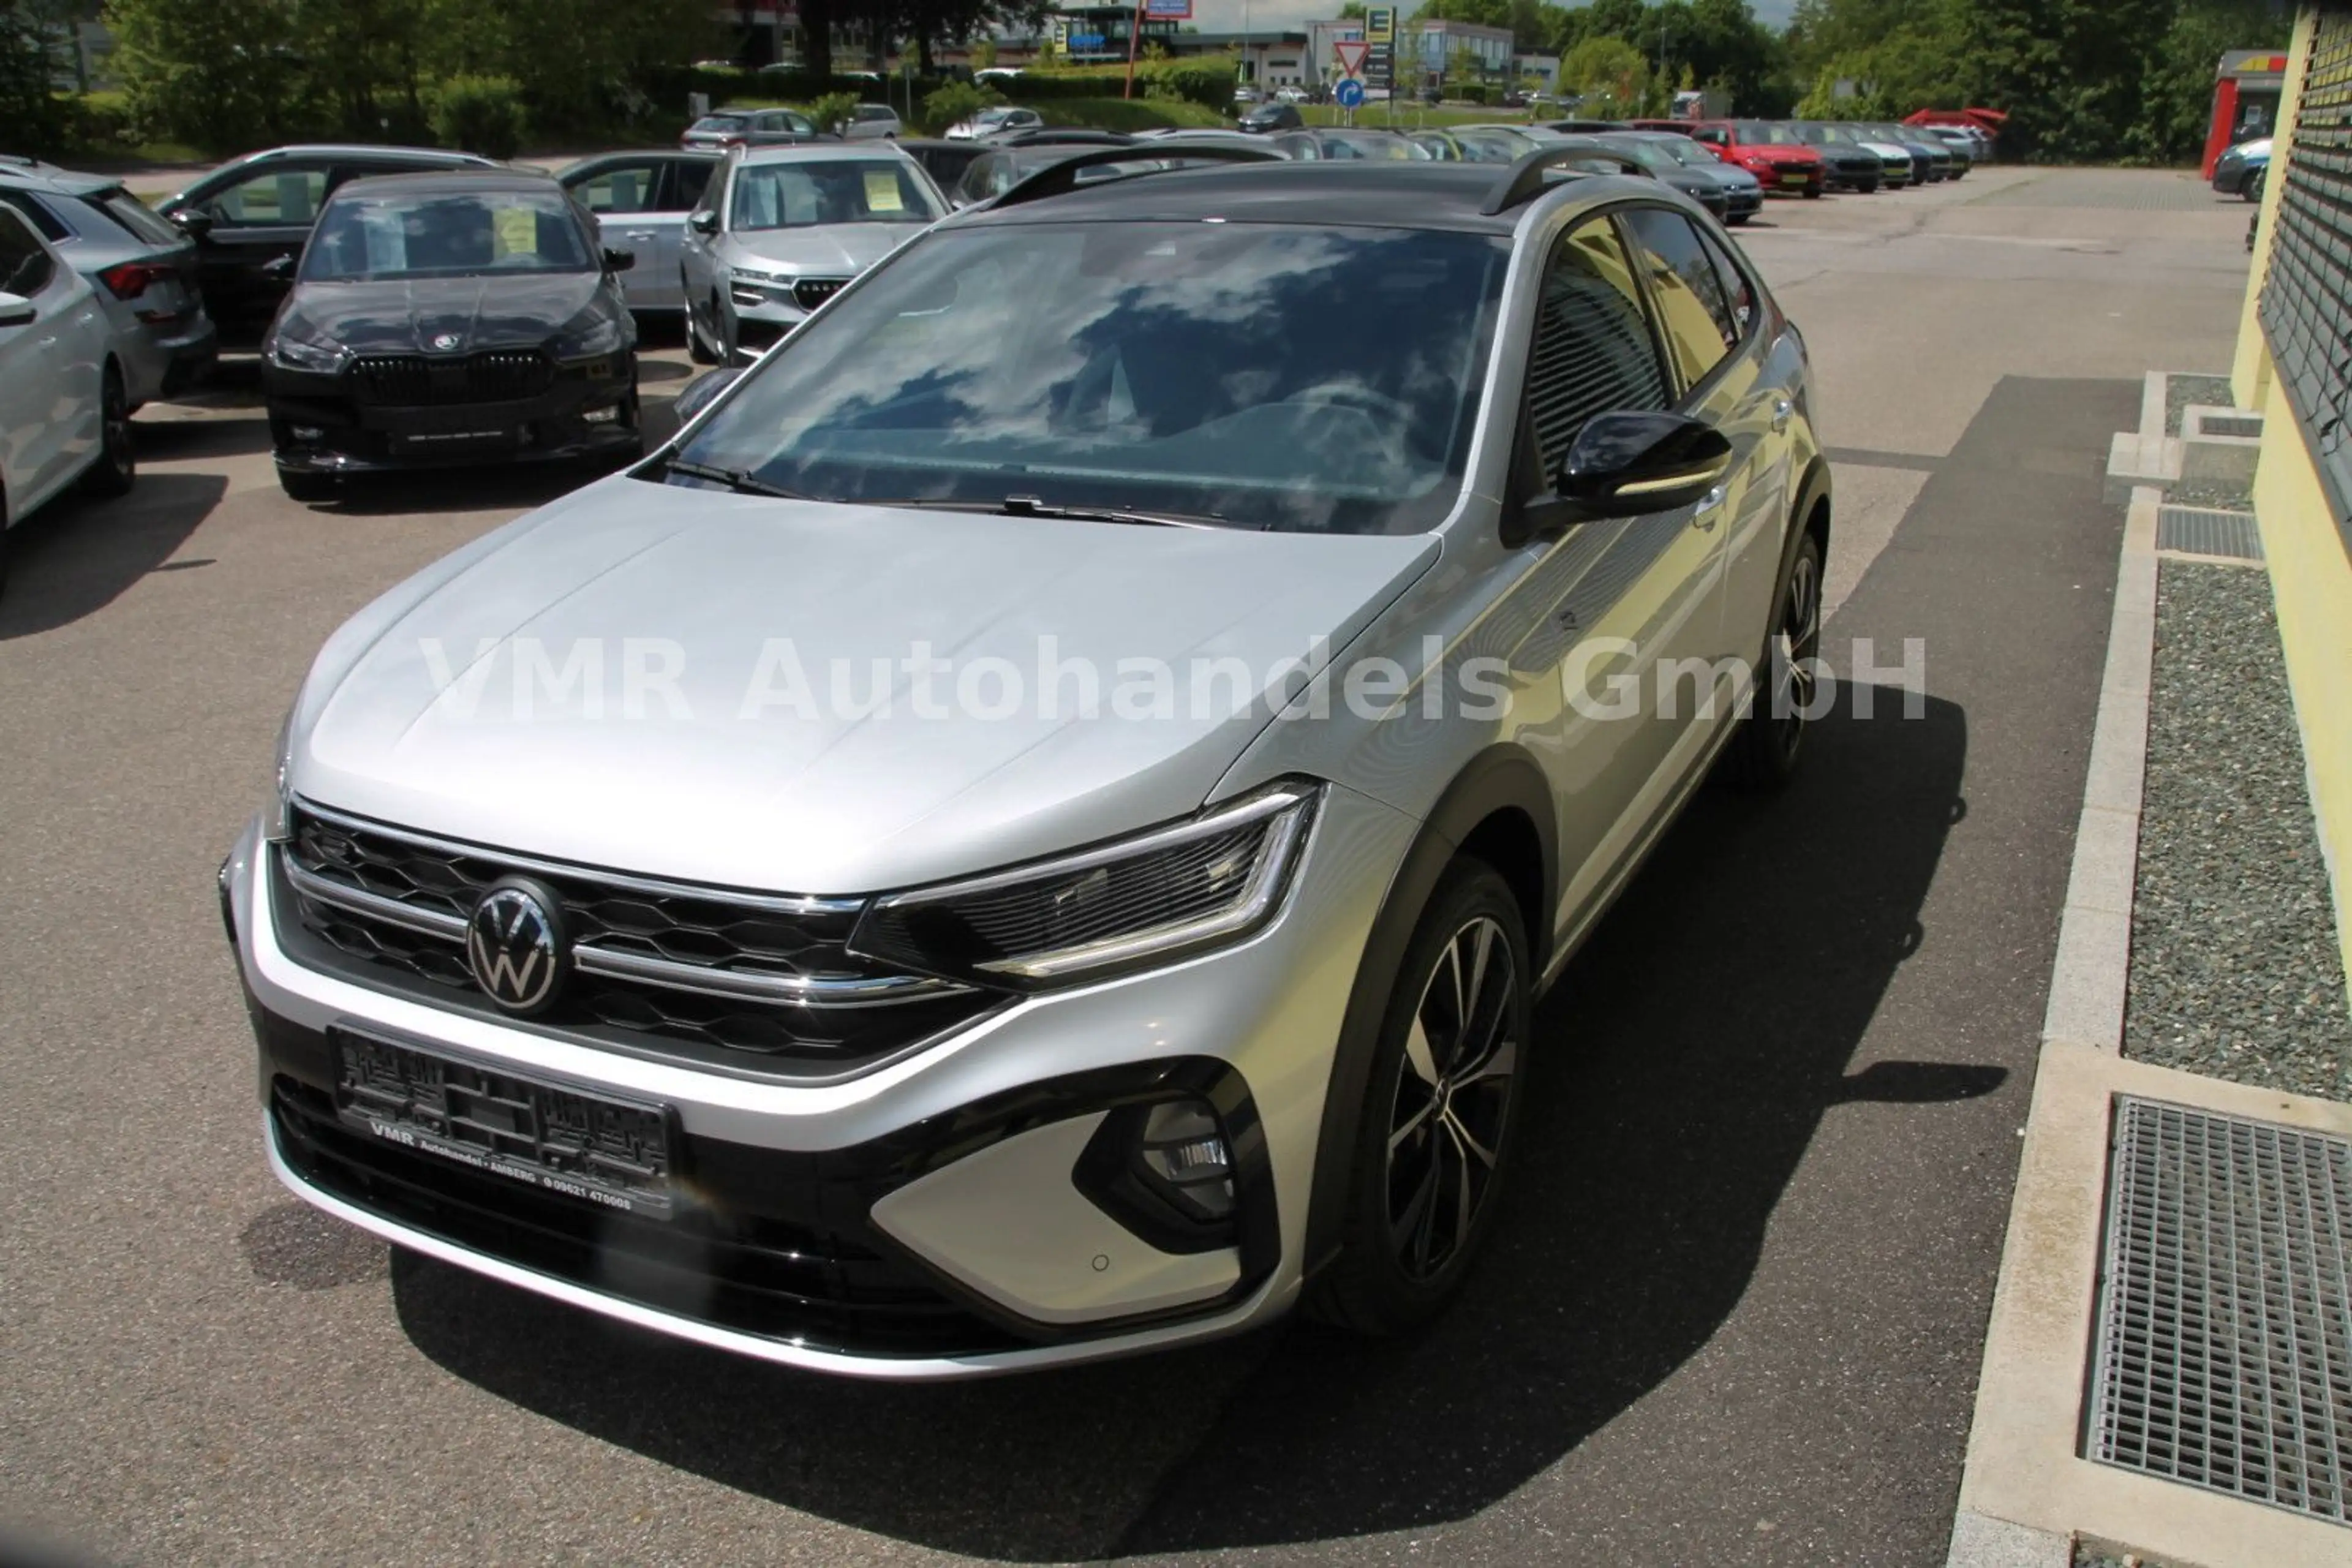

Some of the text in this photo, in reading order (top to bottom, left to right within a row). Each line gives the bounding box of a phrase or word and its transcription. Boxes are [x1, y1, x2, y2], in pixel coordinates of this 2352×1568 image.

[469, 888, 556, 1009] VW
[370, 1121, 415, 1147] VMR
[491, 1161, 537, 1183] AMBERG
